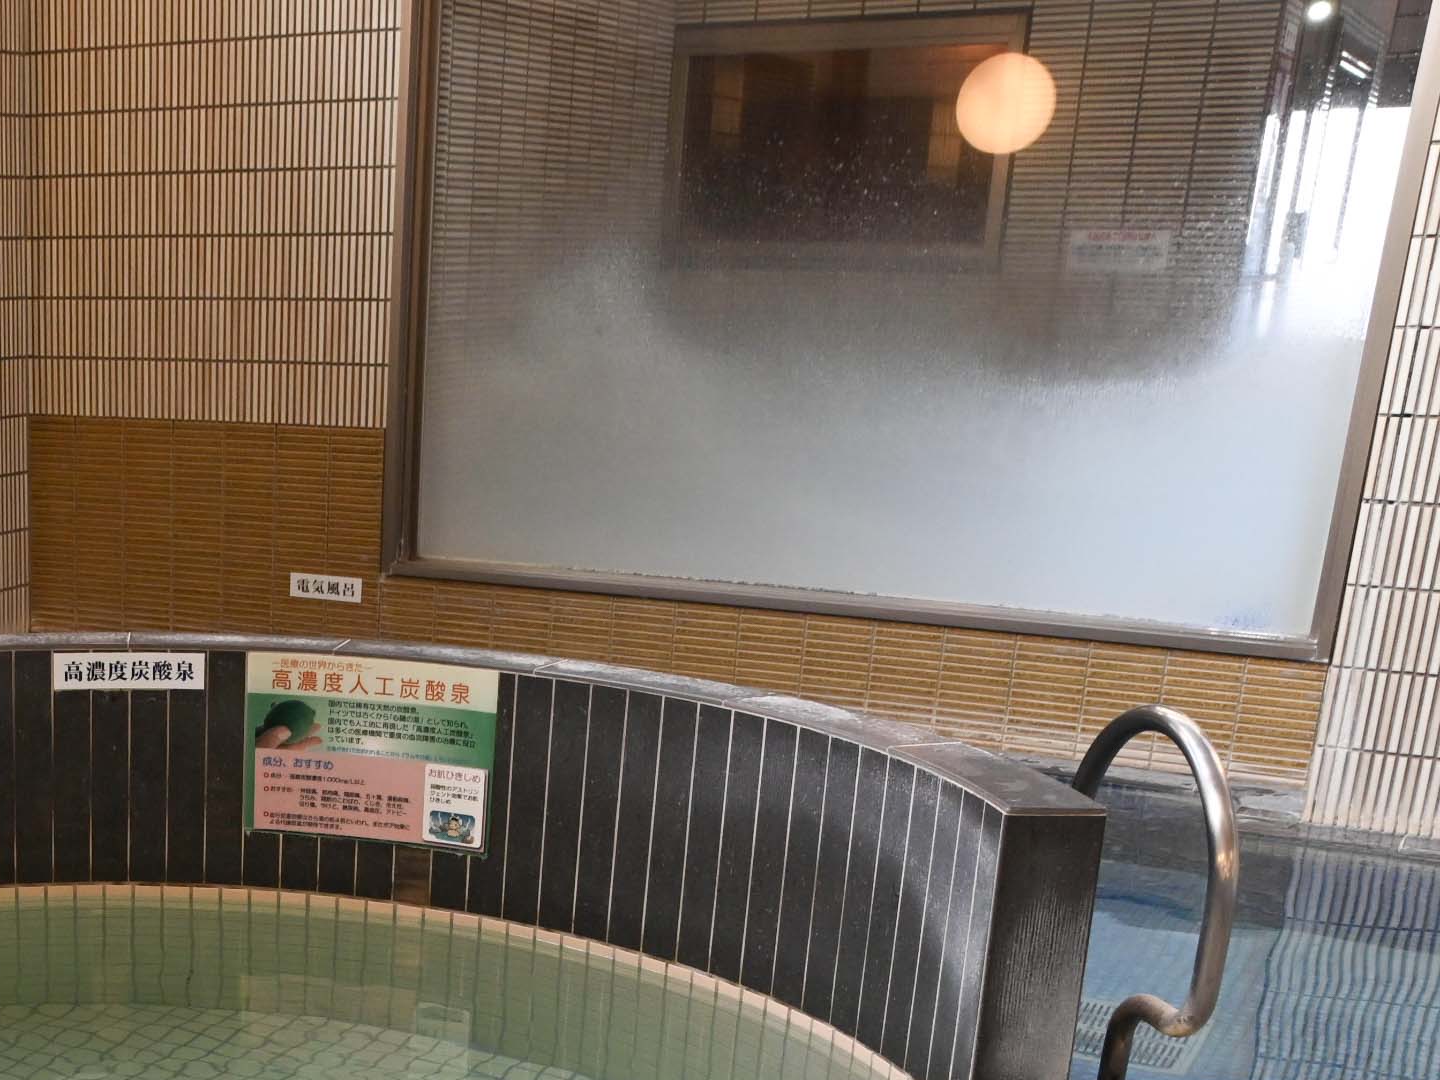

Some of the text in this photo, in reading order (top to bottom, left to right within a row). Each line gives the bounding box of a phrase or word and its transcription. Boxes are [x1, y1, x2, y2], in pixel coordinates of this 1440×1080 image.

[297, 578, 355, 597] 電気風呂
[63, 660, 195, 682] 高濃度炭酸泉
[271, 668, 472, 705] 高濃度人工炭酸泉
[427, 767, 481, 784] お肌ひきしめ
